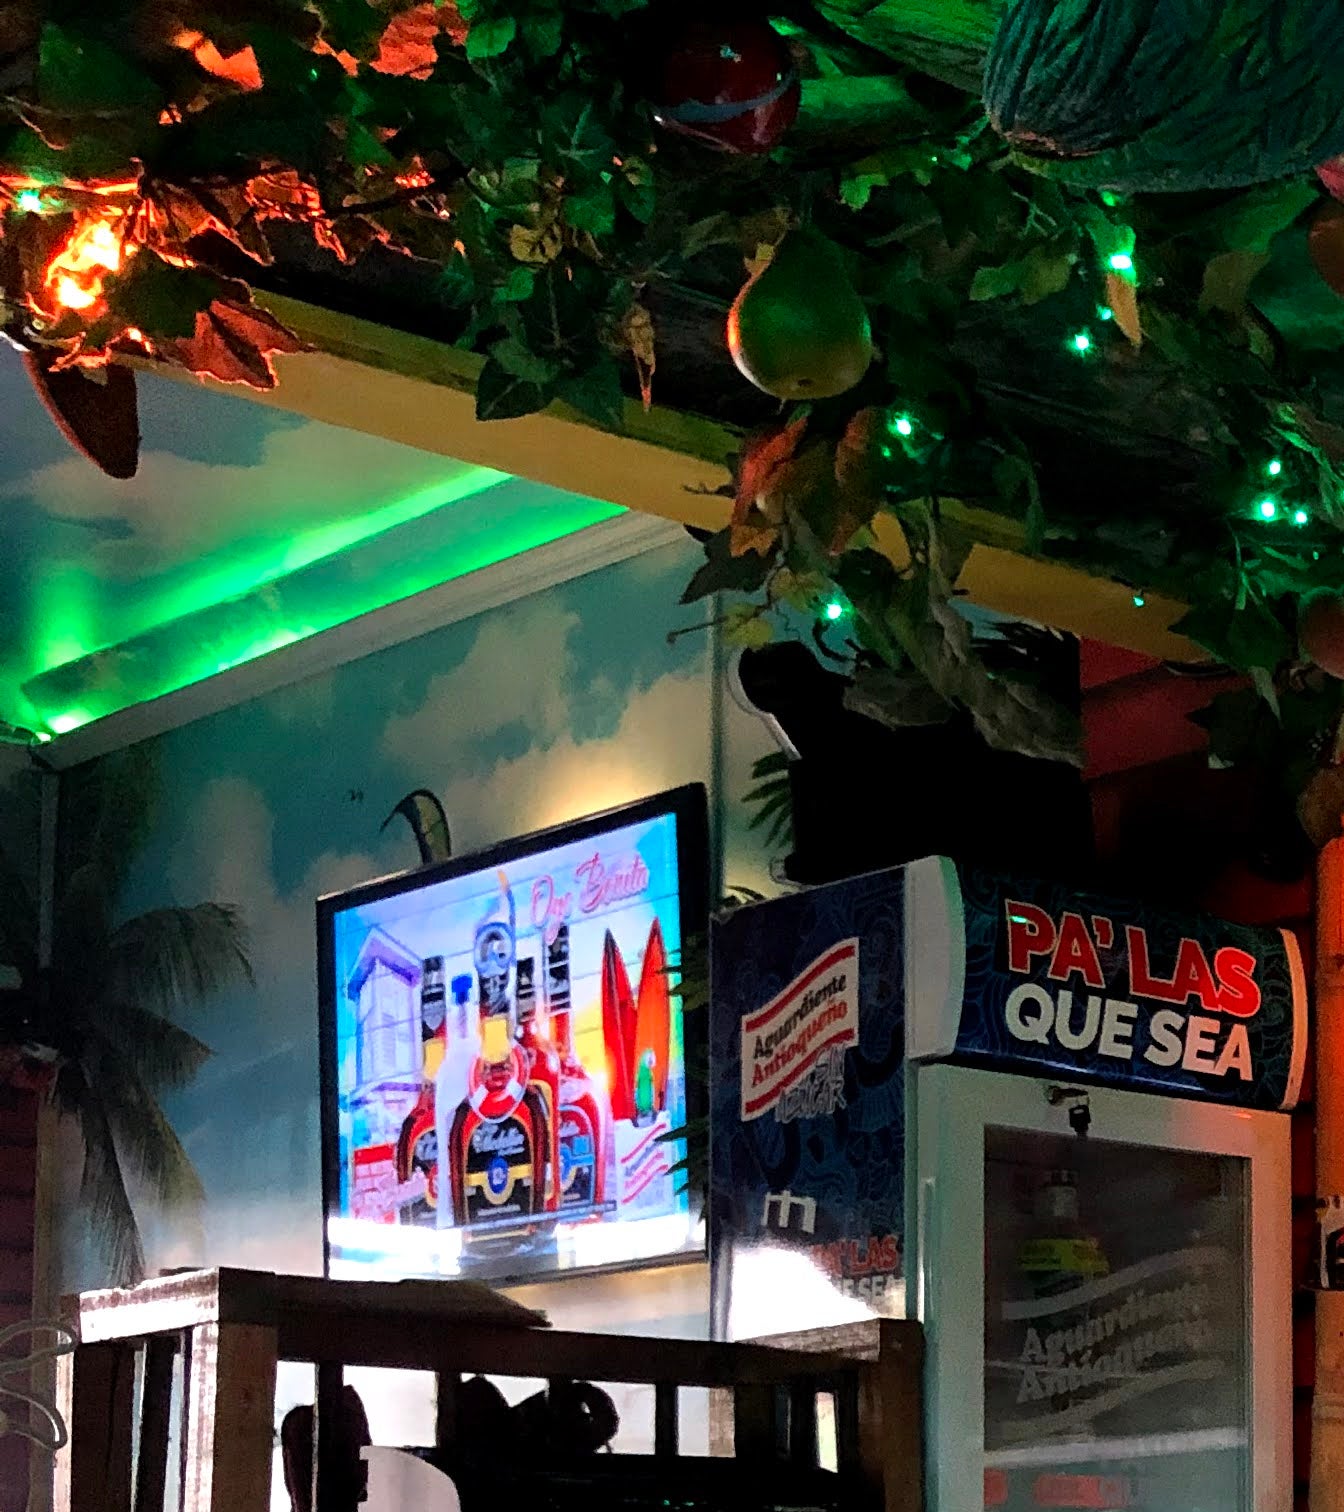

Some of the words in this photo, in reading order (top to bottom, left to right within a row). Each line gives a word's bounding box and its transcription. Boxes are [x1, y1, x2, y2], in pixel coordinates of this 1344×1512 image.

[1005, 899, 1114, 988] PA'
[1125, 925, 1262, 1017] LAS
[751, 996, 848, 1089] Antioqueño
[753, 974, 847, 1060] Aguardiente
[1005, 982, 1139, 1060] QUE
[1144, 1009, 1254, 1081] SEA
